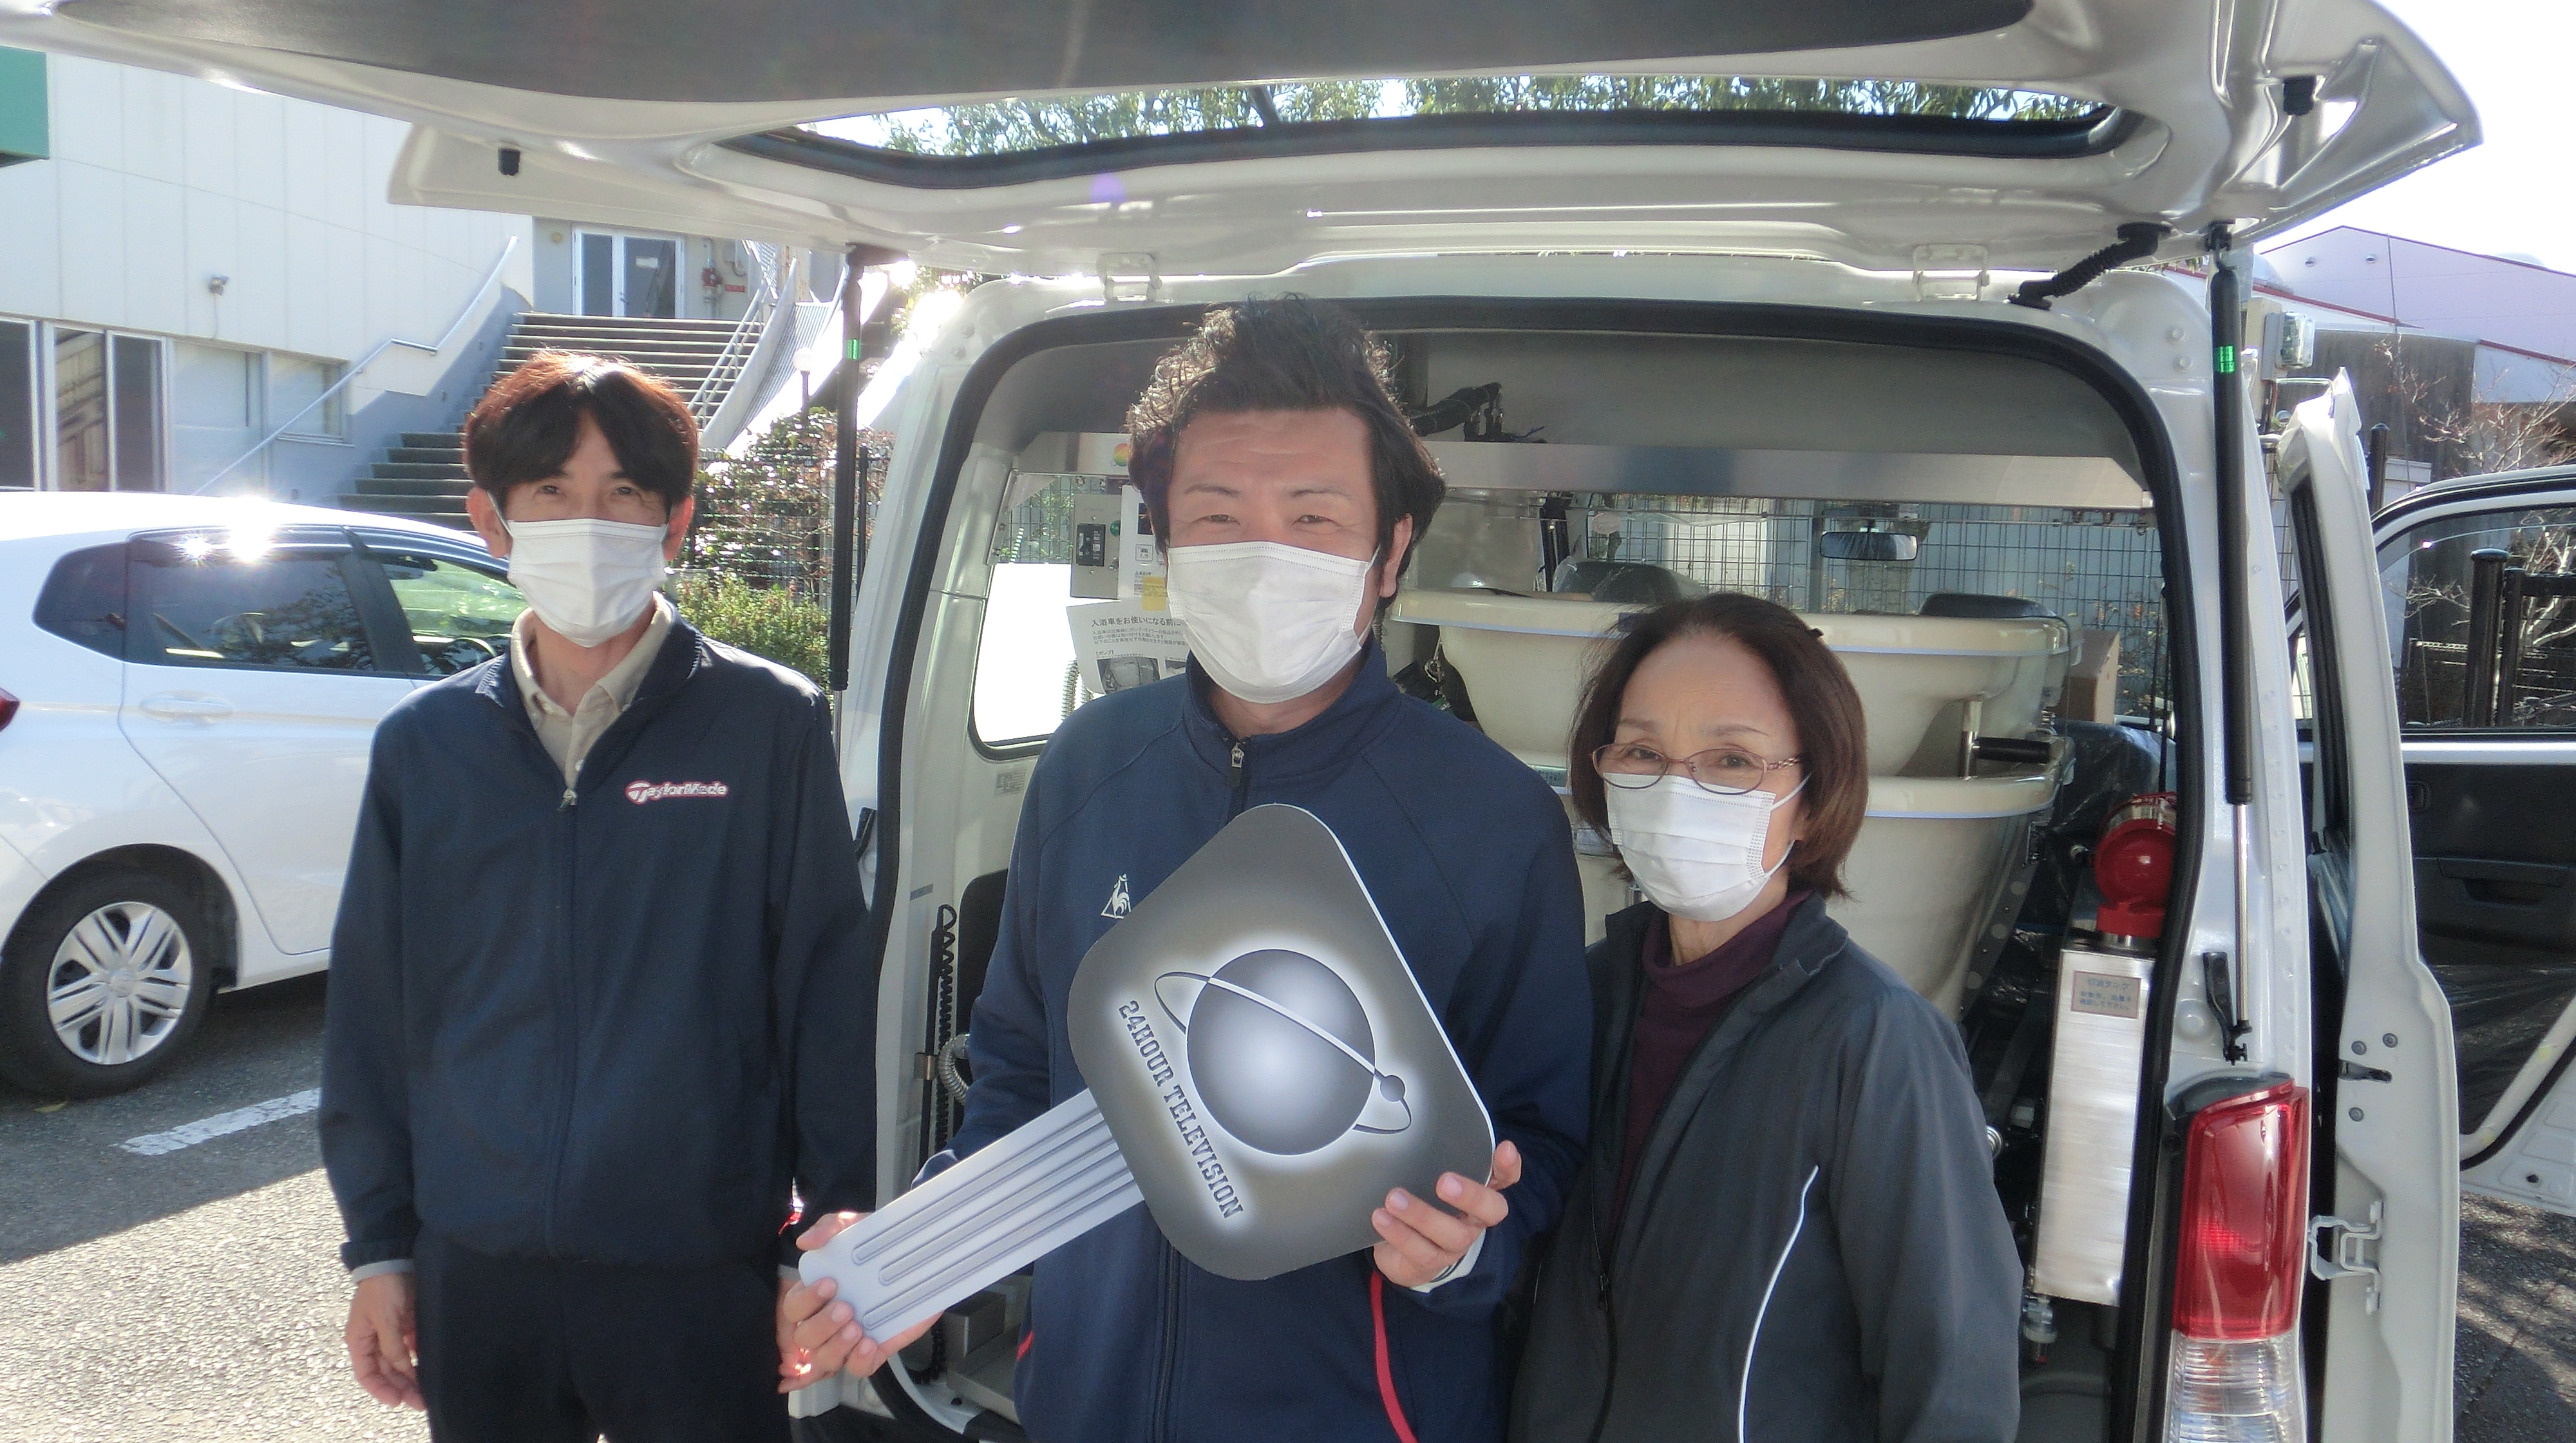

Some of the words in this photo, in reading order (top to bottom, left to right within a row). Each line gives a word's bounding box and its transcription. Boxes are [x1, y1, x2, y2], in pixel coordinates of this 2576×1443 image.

[1092, 616, 1180, 627] 入浴車をお使いになる前に
[629, 782, 727, 803] TaylorMade
[1119, 1000, 1175, 1087] 24HOUR
[1163, 1084, 1244, 1219] TELEVISION
